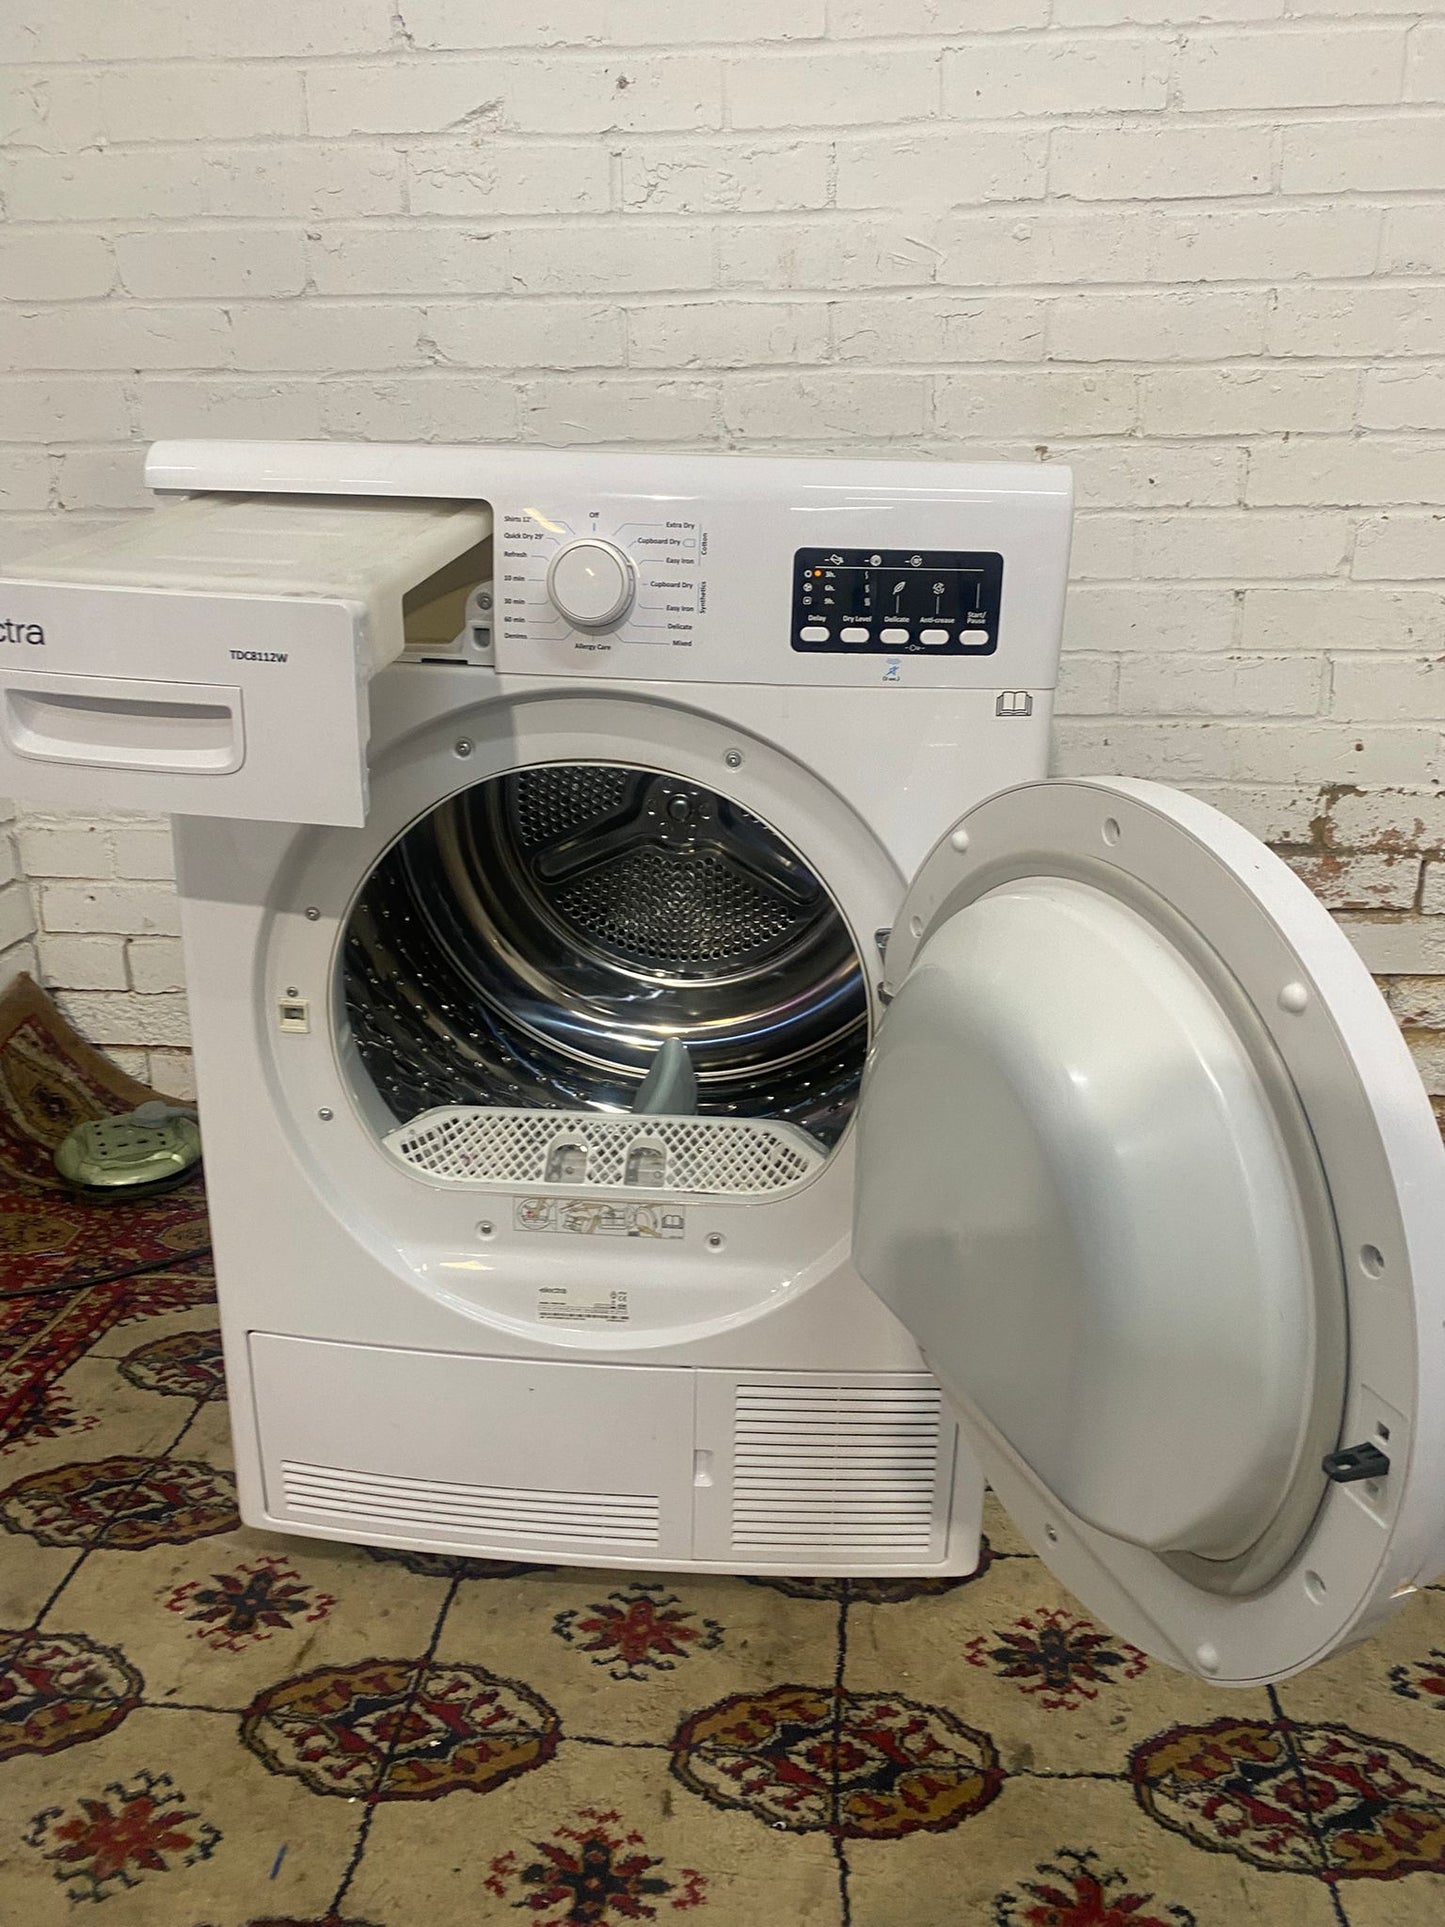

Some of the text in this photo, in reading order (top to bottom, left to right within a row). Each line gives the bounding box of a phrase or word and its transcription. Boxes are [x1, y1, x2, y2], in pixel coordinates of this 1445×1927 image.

[684, 522, 695, 530] Dry
[522, 533, 533, 541] Dry
[637, 537, 681, 546] Cupboard Dry
[650, 581, 693, 590] Cupboard Dry
[808, 614, 827, 622] Delay
[842, 615, 855, 623] Dry
[967, 611, 986, 619] Start/
[920, 616, 955, 624] Anti-crease
[504, 632, 528, 640] Denims
[575, 643, 595, 651] Allergy
[229, 649, 288, 663] TDC8112W
